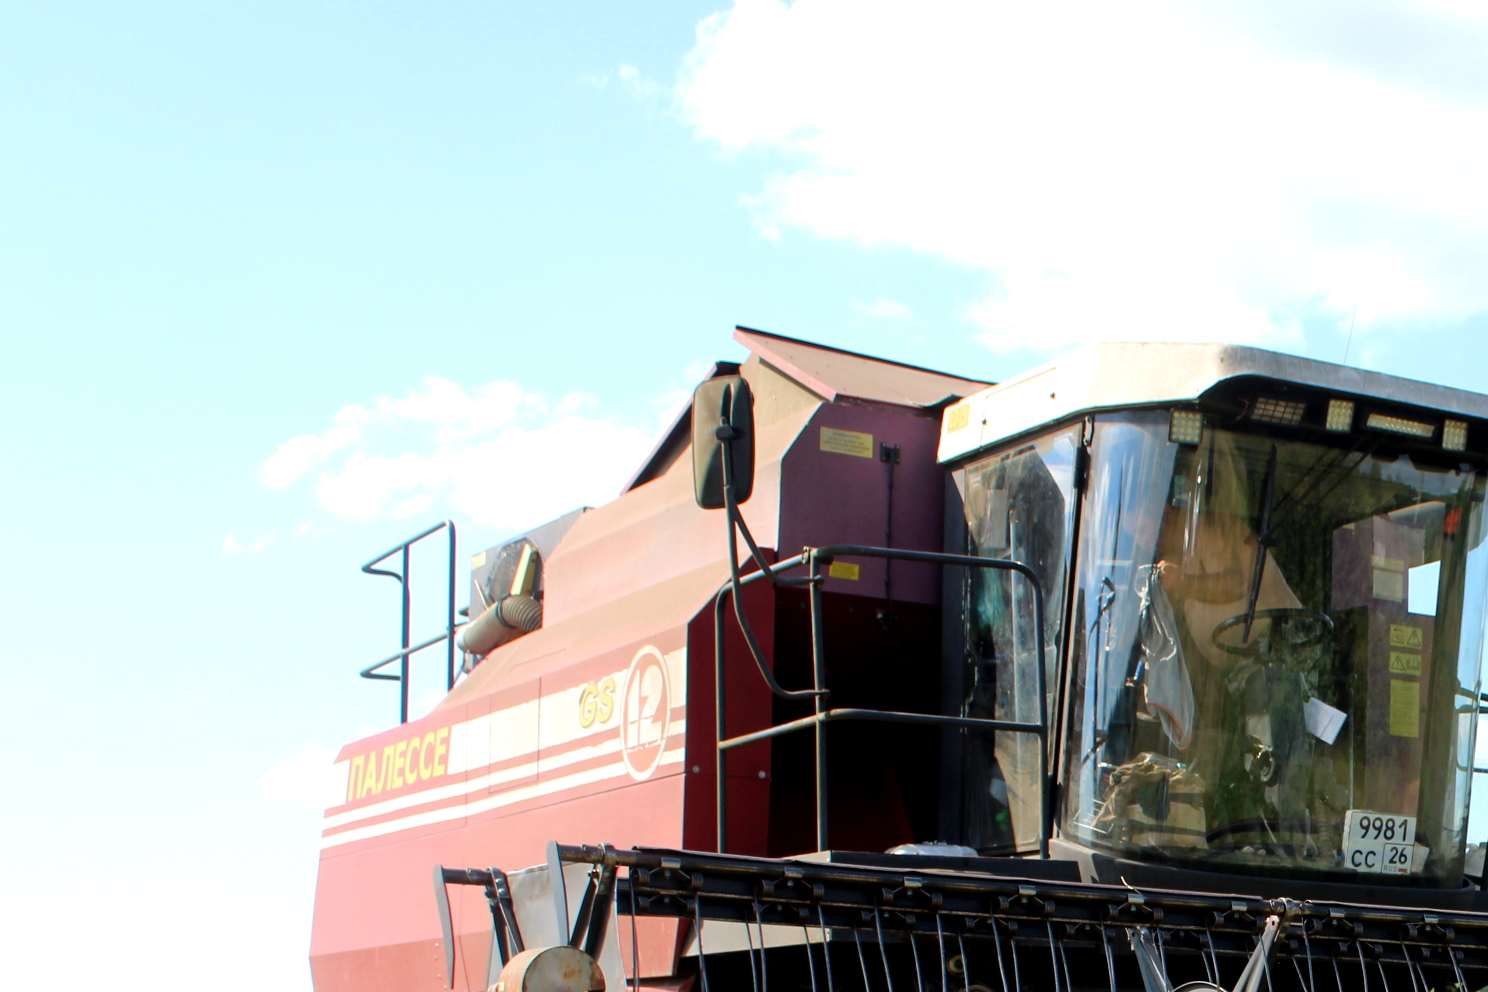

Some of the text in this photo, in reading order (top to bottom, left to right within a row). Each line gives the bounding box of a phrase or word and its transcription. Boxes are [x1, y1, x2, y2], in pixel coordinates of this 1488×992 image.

[579, 678, 616, 728] GS
[347, 726, 450, 802] ПАЛЕССЕ
[1360, 816, 1408, 842] 9981
[1388, 846, 1408, 864] 26
[1383, 864, 1398, 873] RUS
